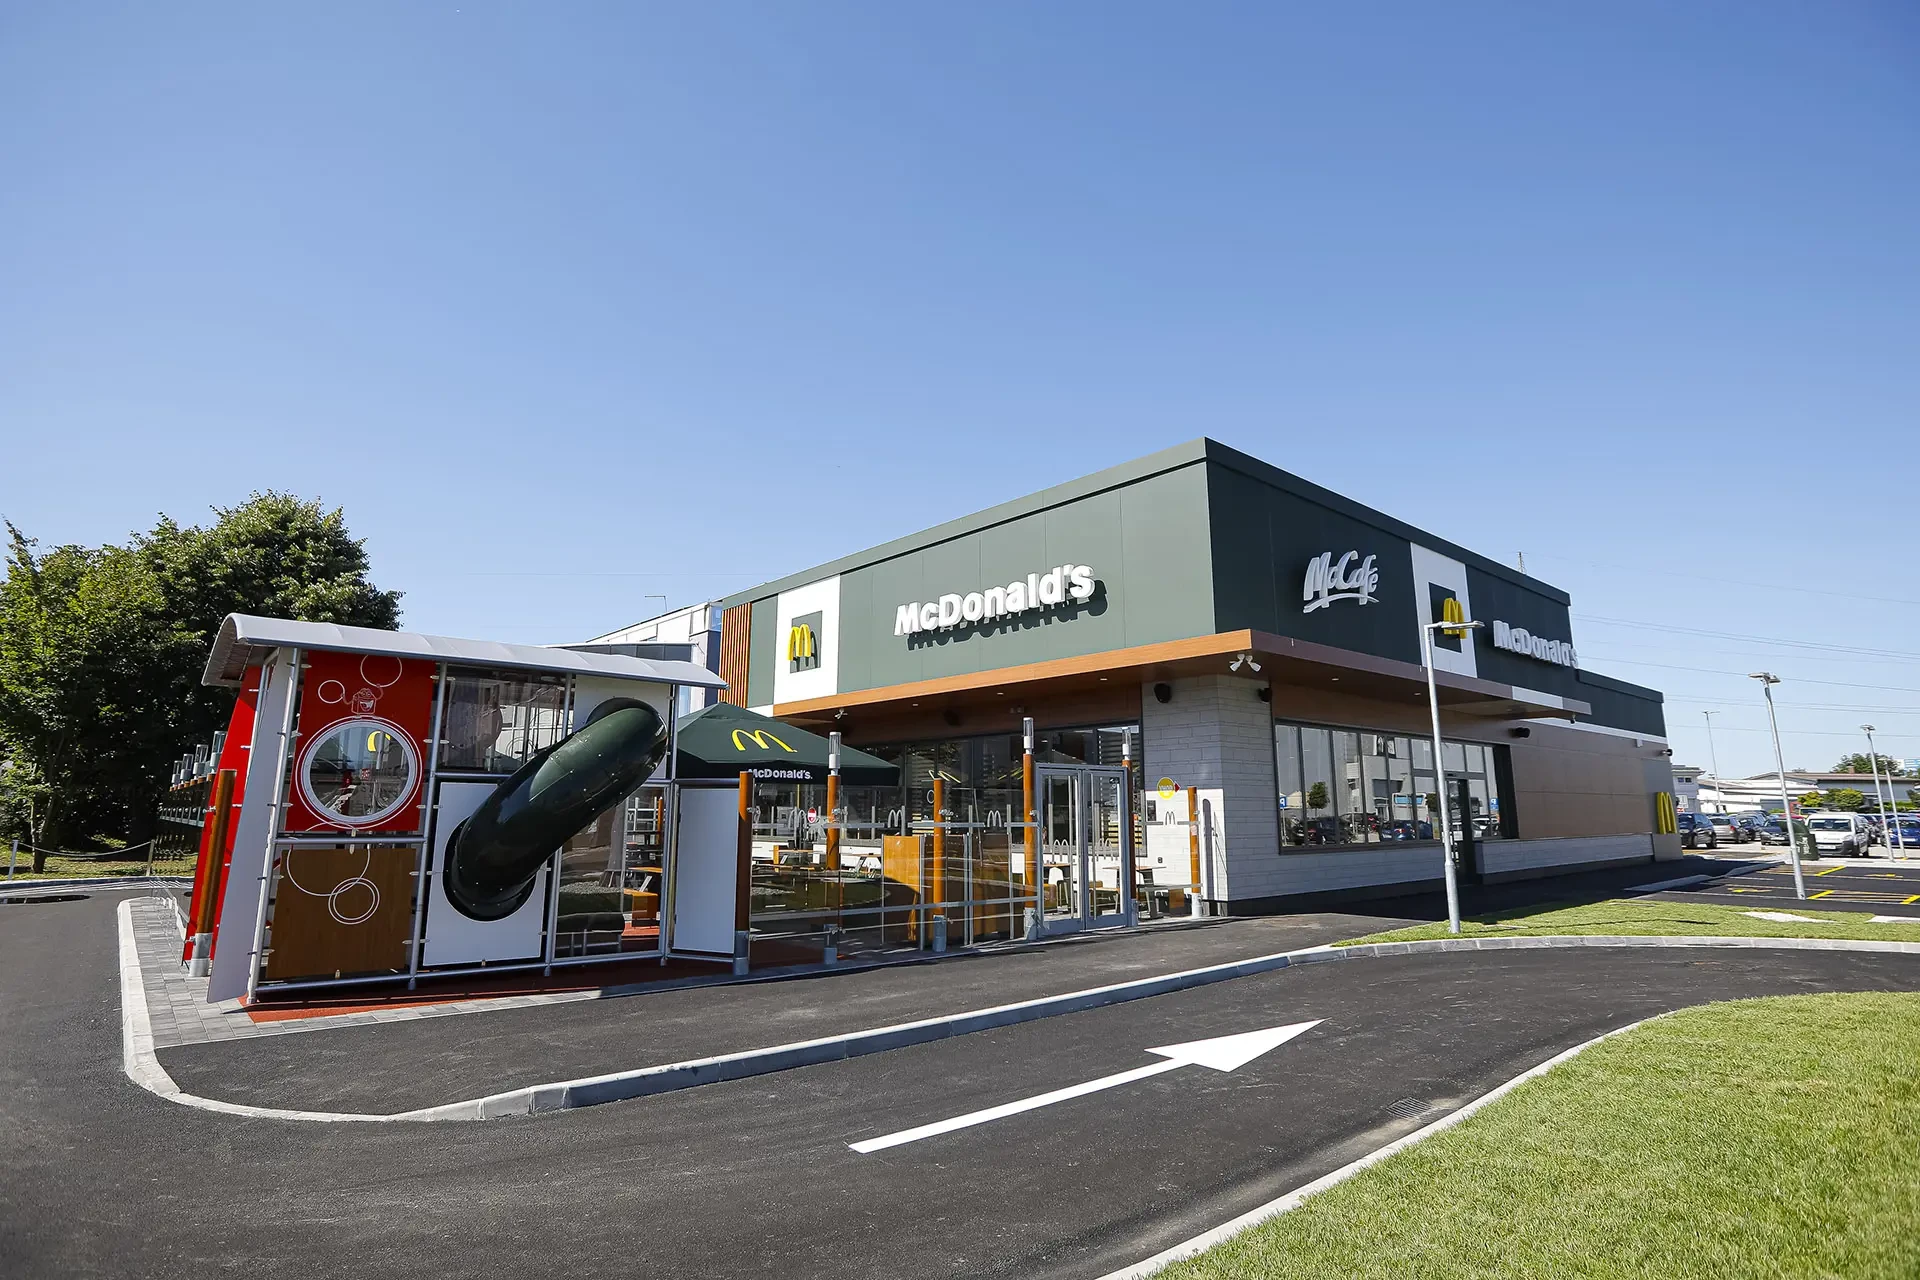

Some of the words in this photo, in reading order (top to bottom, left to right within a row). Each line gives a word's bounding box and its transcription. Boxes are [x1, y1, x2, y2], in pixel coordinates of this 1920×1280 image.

[893, 563, 1096, 637] McDonald's
[1303, 550, 1379, 611] McCafé
[1493, 620, 1579, 669] McDonald's
